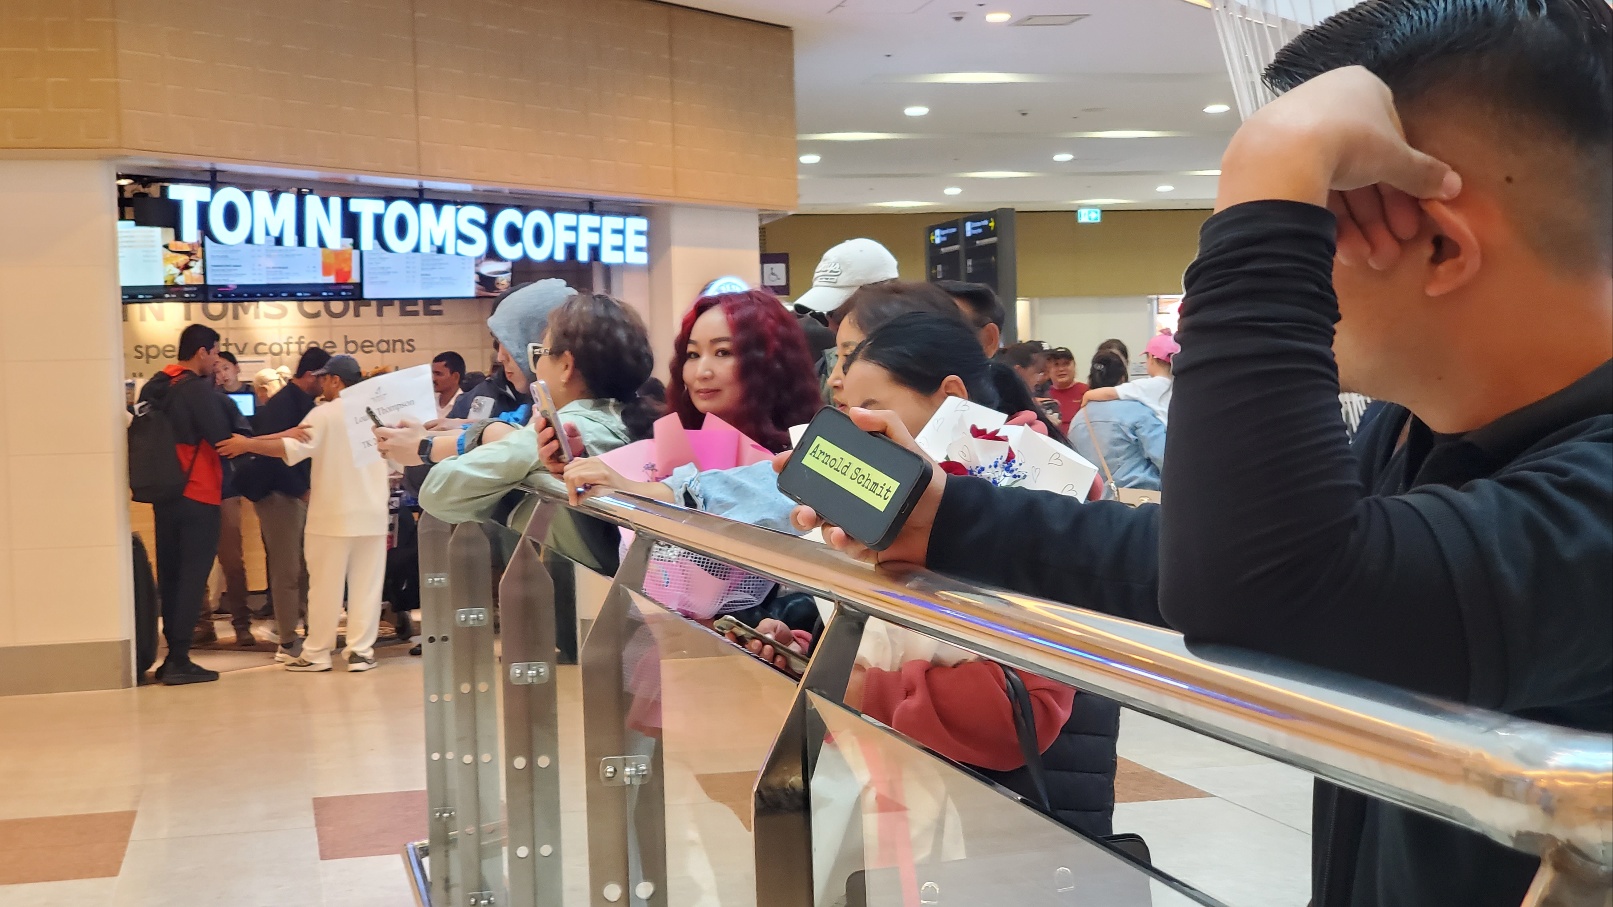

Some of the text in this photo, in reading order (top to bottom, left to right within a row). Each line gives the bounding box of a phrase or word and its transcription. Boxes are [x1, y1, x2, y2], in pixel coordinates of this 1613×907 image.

[168, 185, 297, 247] TOM
[304, 195, 342, 249] N
[348, 199, 488, 257] TOMS
[492, 208, 648, 265] COFFEE
[297, 300, 444, 318] COFFEE
[344, 335, 416, 354] beans
[375, 400, 415, 416] Thompson
[809, 443, 893, 501] Arnold Schmit
